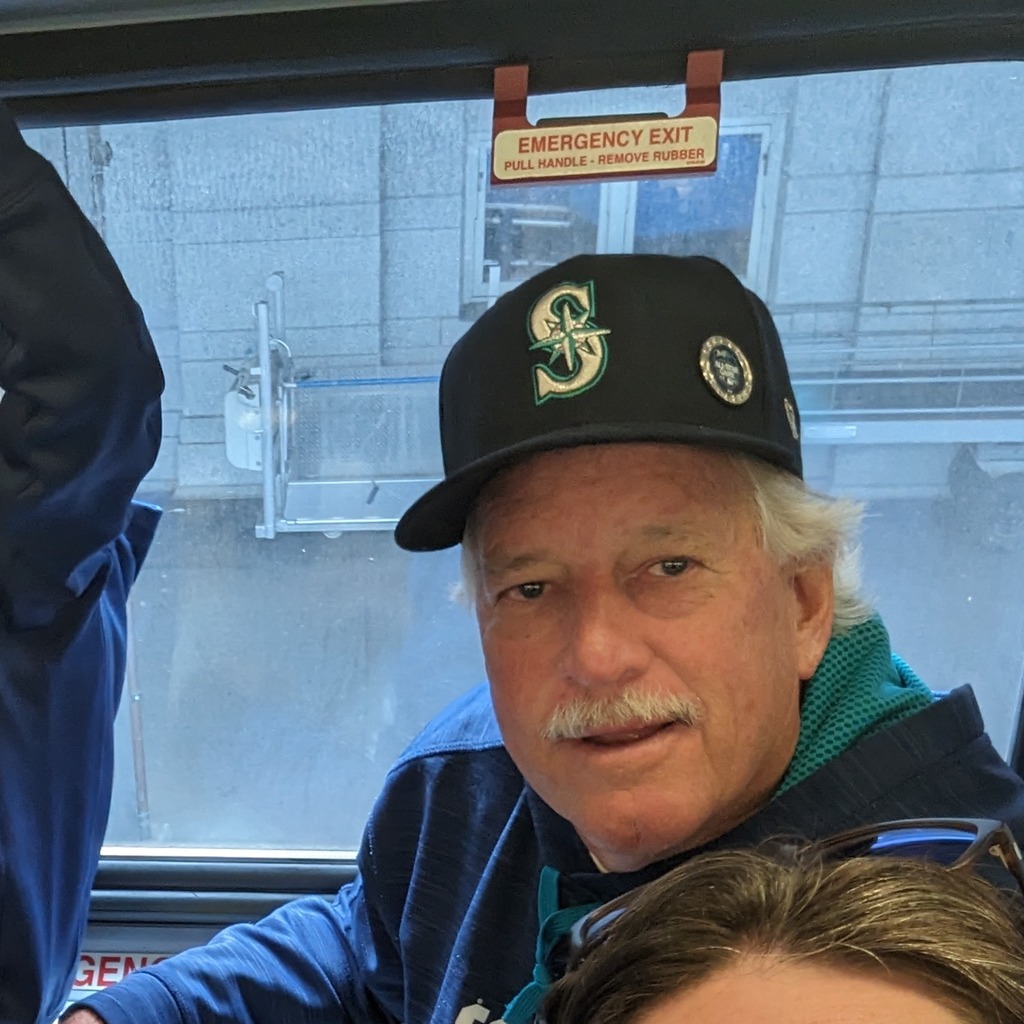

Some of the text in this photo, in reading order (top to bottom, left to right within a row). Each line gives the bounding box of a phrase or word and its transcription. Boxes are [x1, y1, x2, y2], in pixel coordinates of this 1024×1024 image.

[518, 126, 693, 153] EMERGENCY EXIT
[504, 160, 534, 171] PULL
[538, 157, 587, 169] HANDLE
[598, 152, 649, 165] REMOVE
[654, 148, 705, 161] RUBBER
[73, 954, 168, 987] GEN
